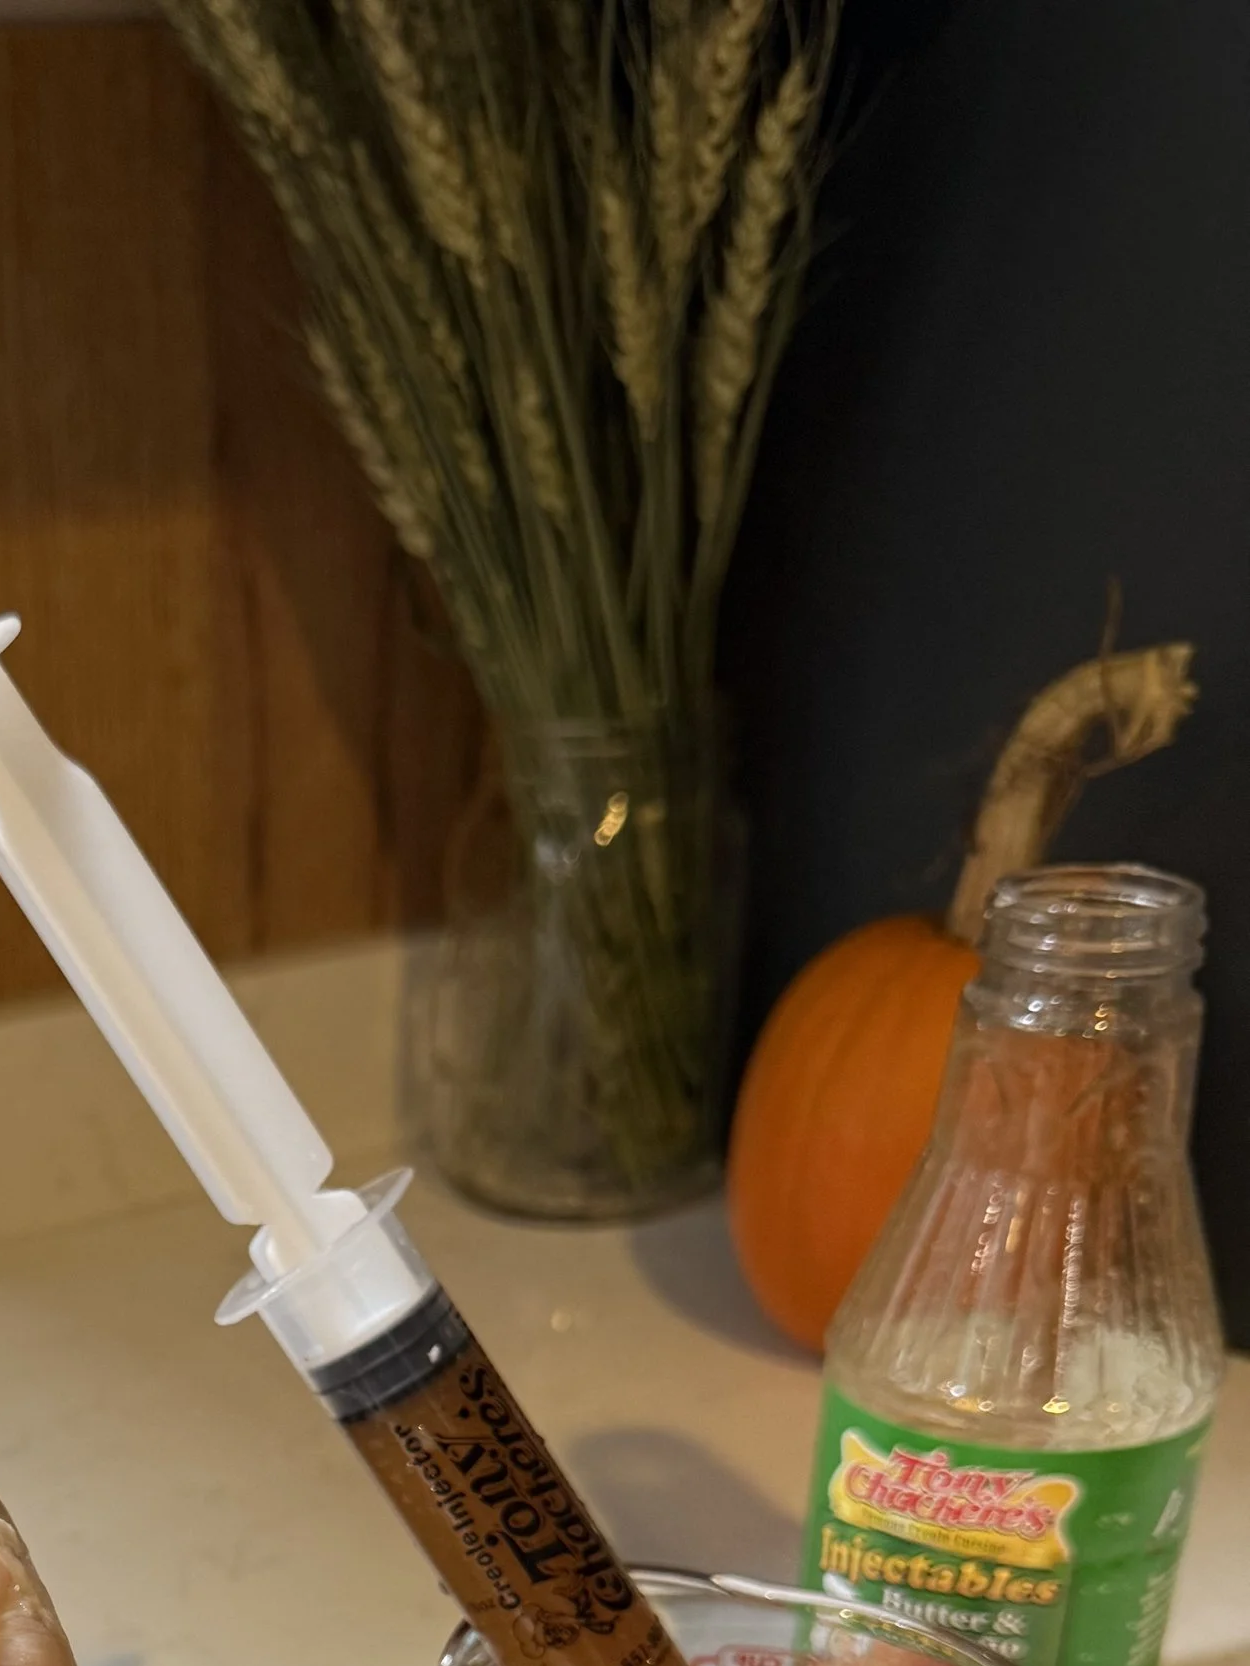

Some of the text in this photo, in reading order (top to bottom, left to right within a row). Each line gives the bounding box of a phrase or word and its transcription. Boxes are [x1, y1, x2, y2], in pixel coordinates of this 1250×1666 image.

[394, 1424, 473, 1532] Injector
[435, 1433, 576, 1585] Tony
[459, 1367, 634, 1612] Chachere's
[844, 1464, 1053, 1540] Chachere's
[888, 1447, 1035, 1502] Tony
[462, 1531, 521, 1610] Creole
[820, 1523, 1060, 1605] Injectables
[882, 1587, 1029, 1636] Butter &
